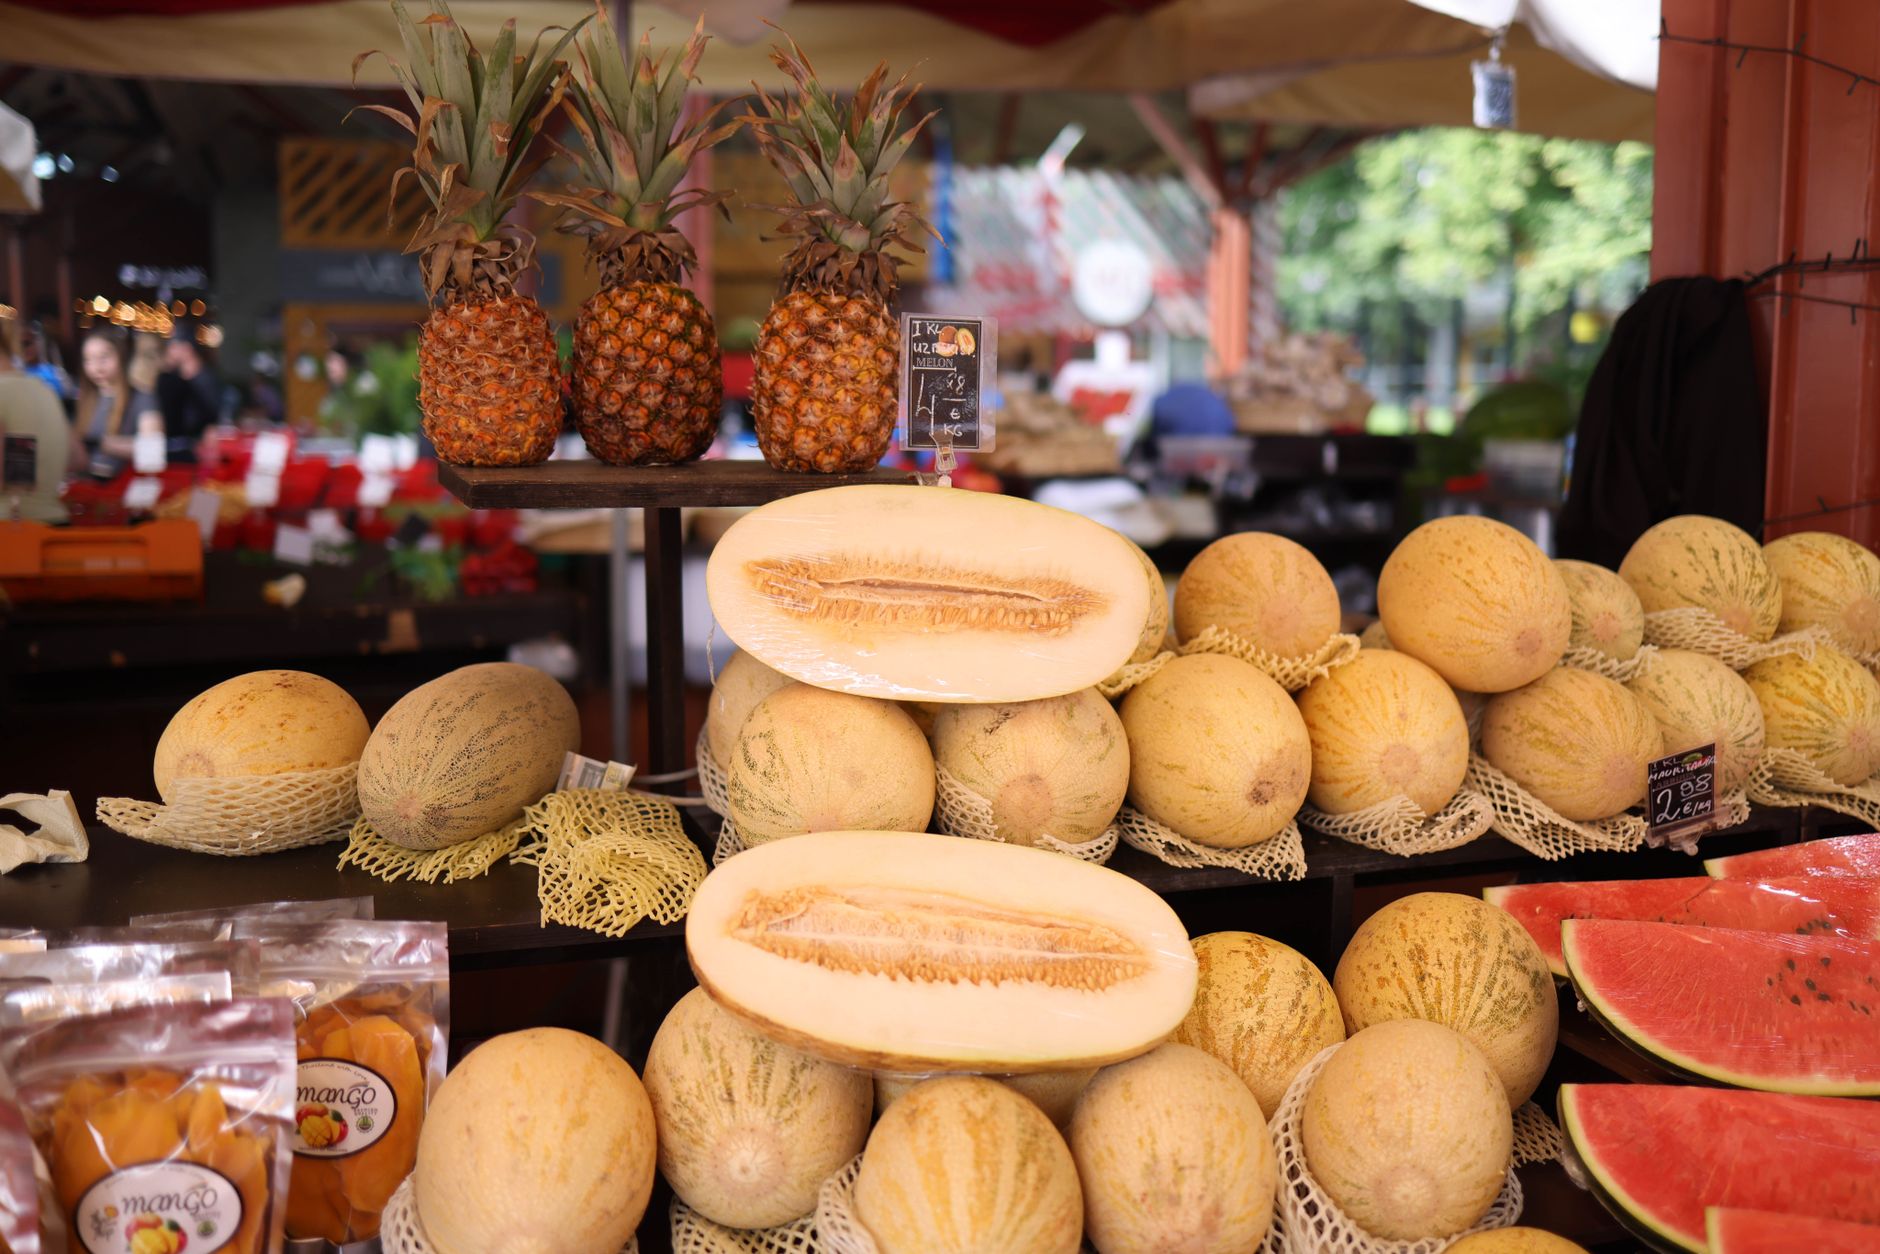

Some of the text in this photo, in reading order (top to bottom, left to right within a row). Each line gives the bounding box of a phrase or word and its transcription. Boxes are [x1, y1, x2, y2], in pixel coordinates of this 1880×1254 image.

[916, 357, 954, 368] MELON
[943, 423, 963, 437] KG
[297, 1086, 376, 1109] mango
[121, 1187, 218, 1217] mango
